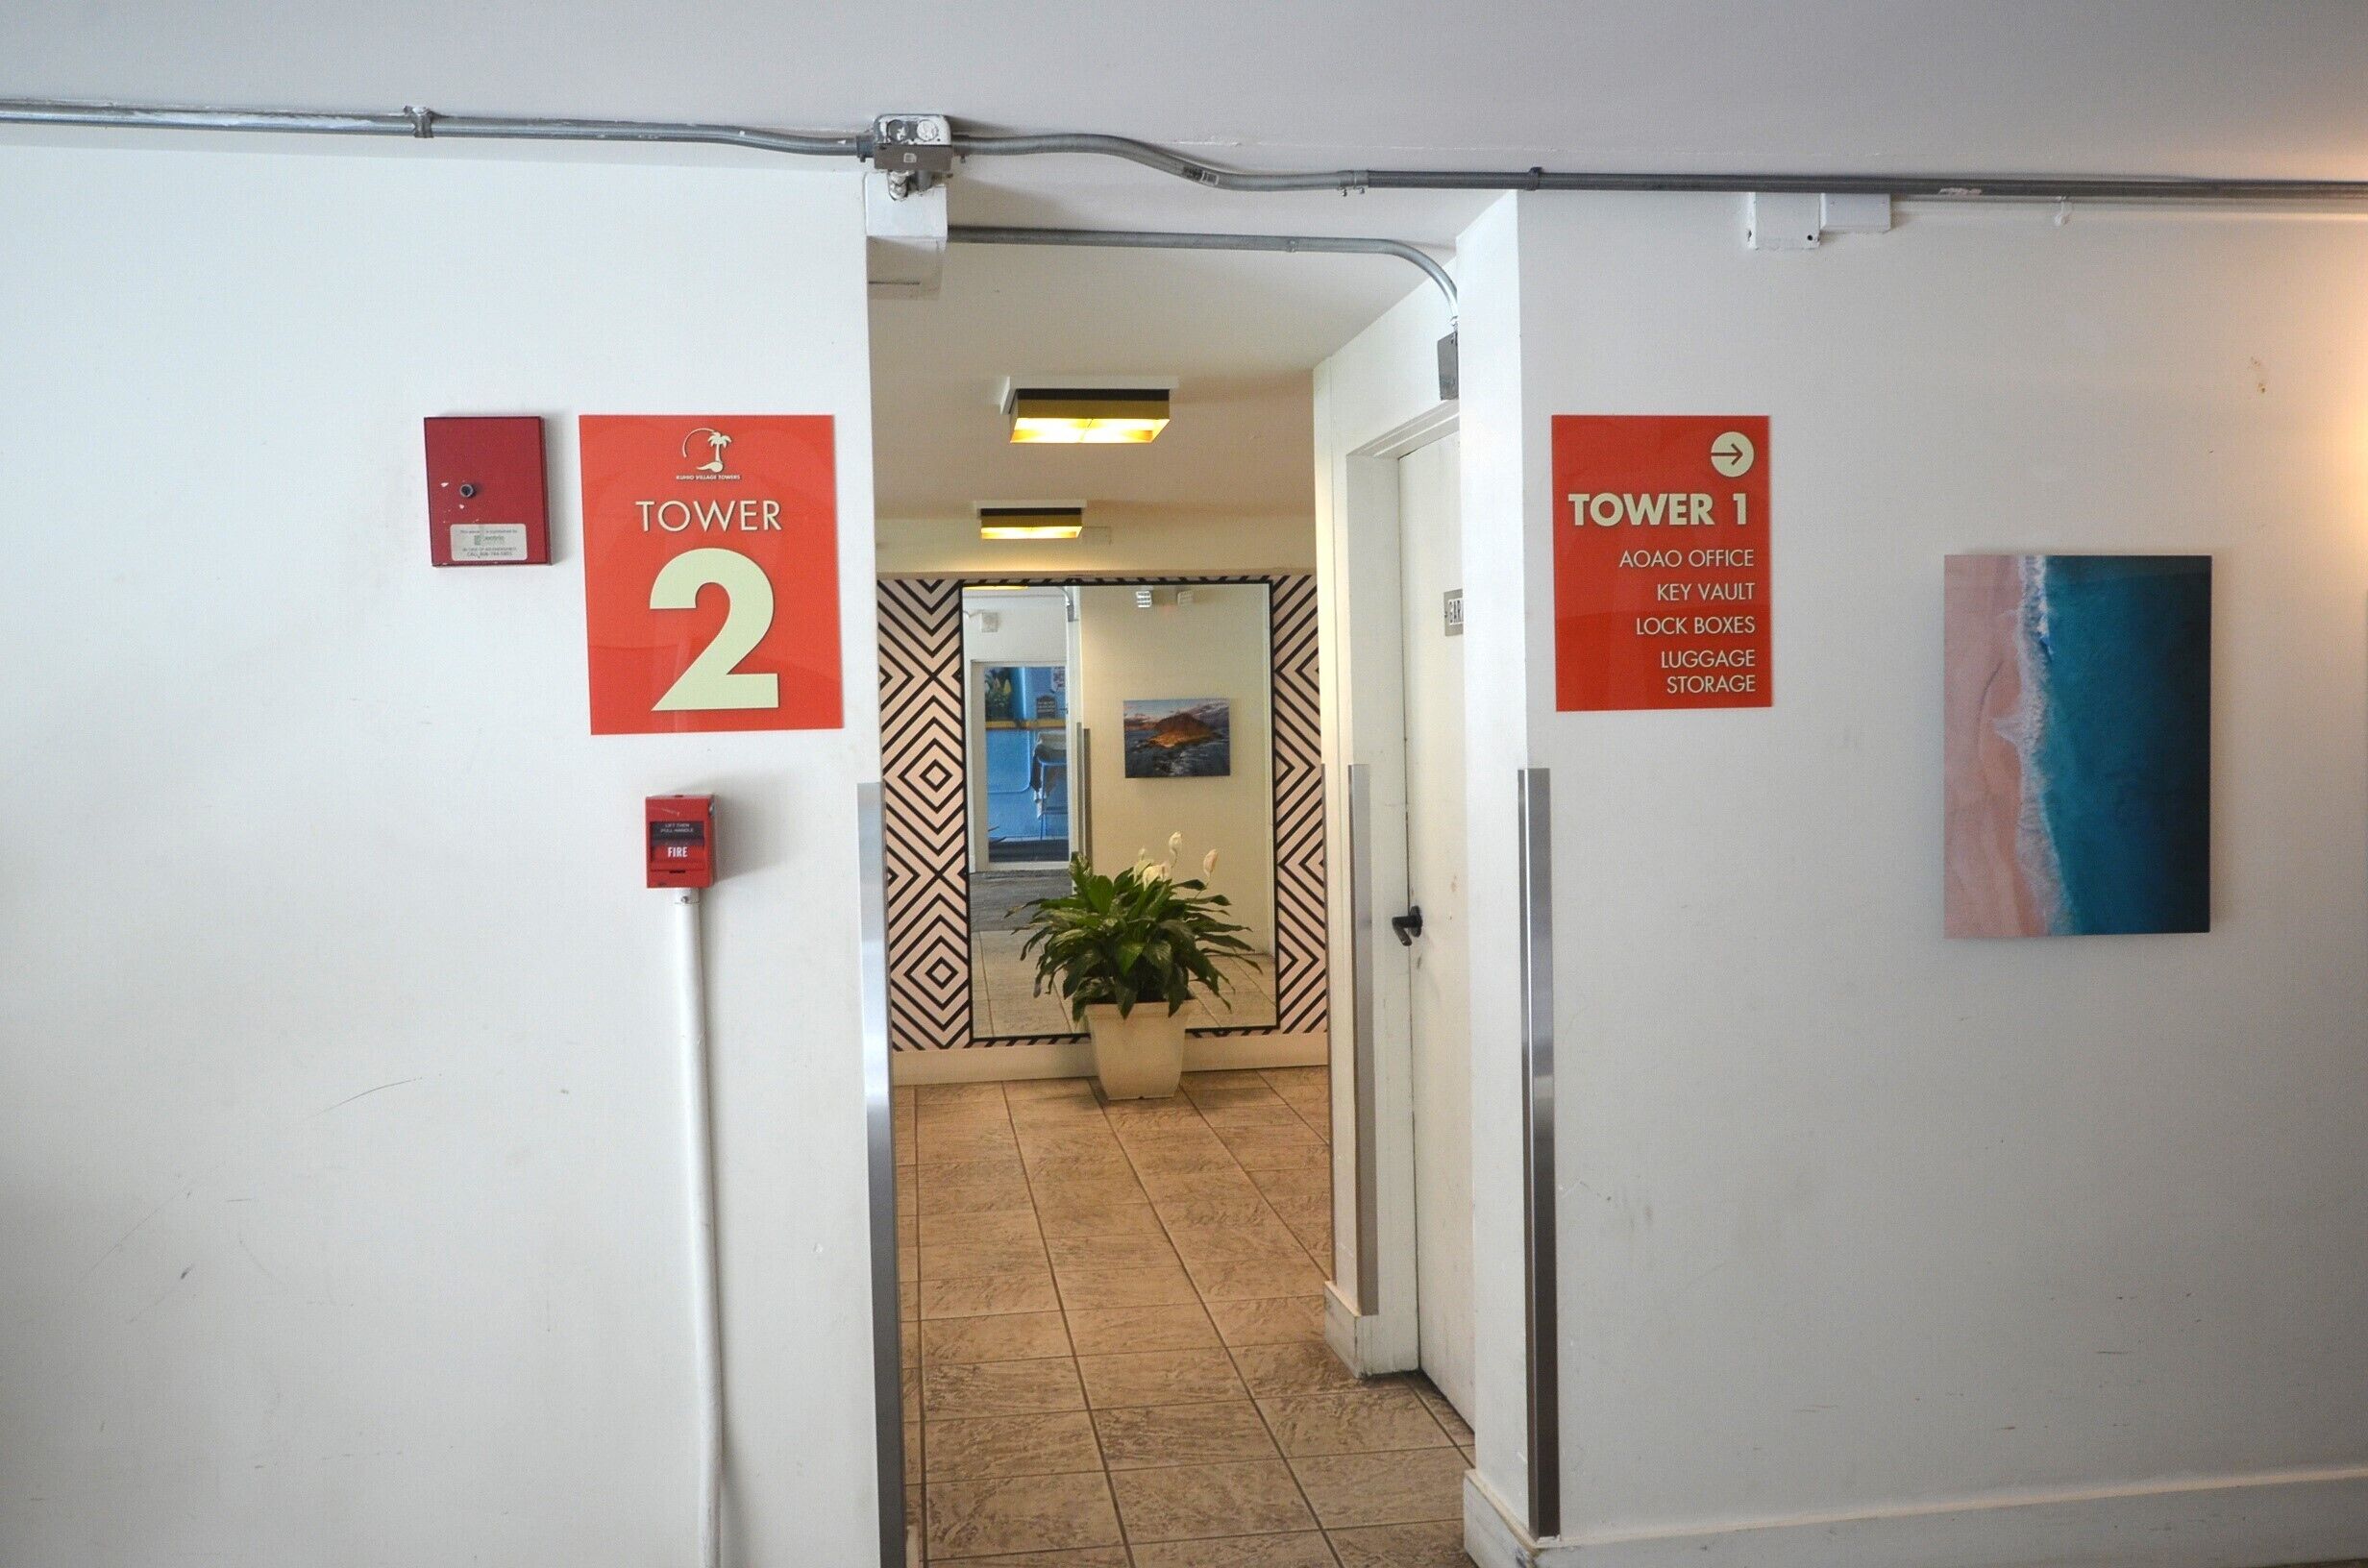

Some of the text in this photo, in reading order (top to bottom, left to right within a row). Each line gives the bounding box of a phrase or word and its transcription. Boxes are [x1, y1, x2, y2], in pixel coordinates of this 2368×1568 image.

[634, 499, 783, 532] TOWER
[1567, 492, 1748, 527] TOWER 1
[1618, 549, 1755, 569] AOAO OFFICE
[1657, 582, 1756, 601] KEY VAULT
[649, 547, 779, 712] 2
[1636, 616, 1756, 636] LOCK BOXES
[1661, 649, 1756, 669] LUGGAGE
[1666, 674, 1757, 694] STORAGE
[667, 846, 688, 858] FIRE
